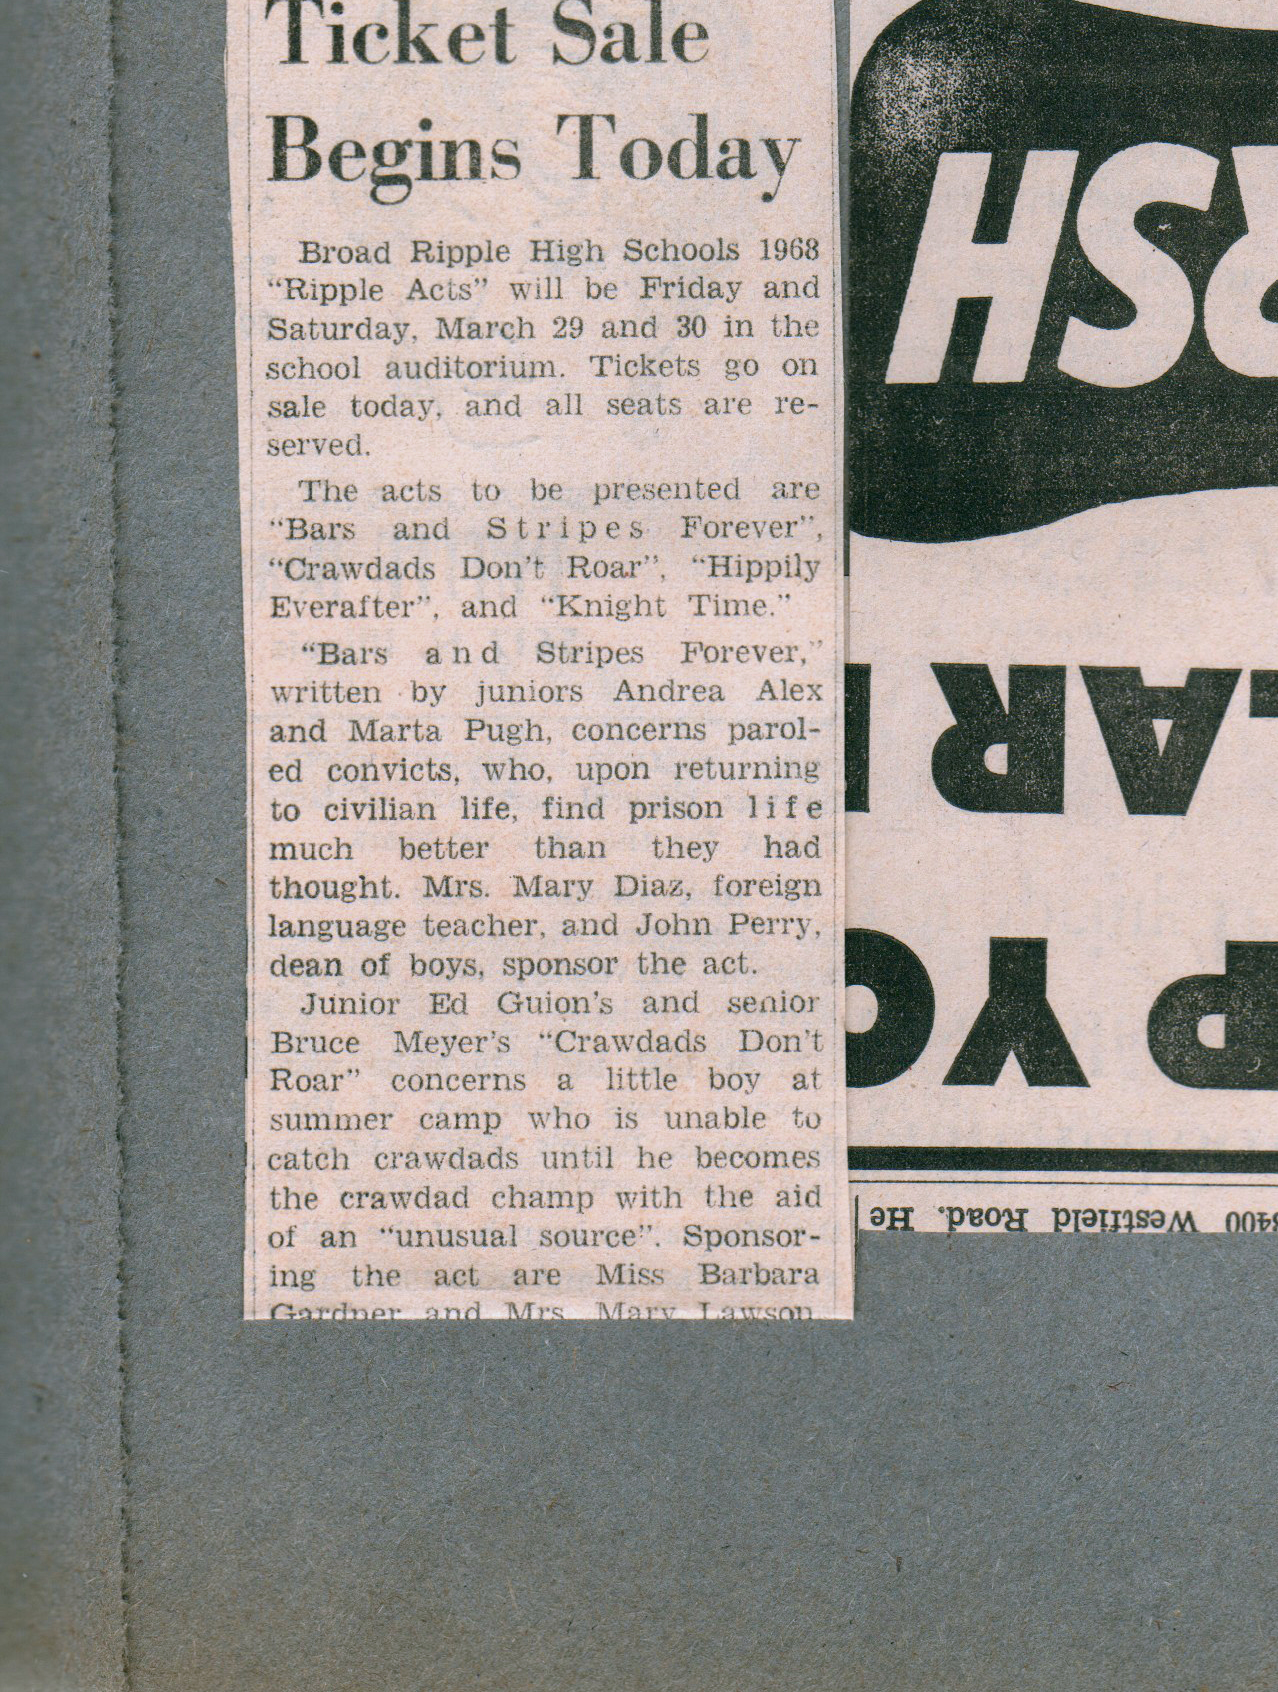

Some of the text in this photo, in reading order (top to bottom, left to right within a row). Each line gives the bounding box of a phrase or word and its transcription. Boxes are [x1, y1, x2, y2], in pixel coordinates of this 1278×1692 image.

[268, 114, 800, 203] Begins Today
[298, 237, 819, 268] Broad Ripple High Schools 1968
[268, 275, 819, 306] "Ripple Acts" will be Friday and
[268, 314, 819, 345] Saturday, March 29 and 30 in the
[265, 354, 817, 381] school auditorium. Tickets go on
[267, 393, 818, 421] sale today, and all seats are re-
[267, 433, 370, 457] served.
[298, 477, 820, 506] The acts to be presented are
[269, 553, 820, 583] "Crawdads Don't Roar", "Hippily
[270, 594, 790, 622] Everafter", and "Knight Time."
[271, 678, 822, 707] written by juniors Andrea Alex
[270, 717, 820, 746] and Marta Pugh, concerns parol-
[268, 756, 820, 785] ed convicts, who, upon returning
[271, 799, 301, 822] to
[324, 797, 436, 822] civilian
[461, 796, 517, 823] life,
[542, 796, 604, 820] find
[629, 796, 723, 824] prison
[269, 834, 820, 863] much better than they had
[269, 874, 822, 904] thought. Mrs. Mary Diaz, foreign
[268, 913, 820, 942] language teacher, and John Perry,
[270, 952, 757, 981] dean of boys, sponsor the act.
[300, 990, 820, 1015] Junior Ed Guion's and senior
[271, 1029, 822, 1057] Bruce Meyer's "Crawdads Don't
[270, 1067, 820, 1094] Roar" concerns a little boy at
[270, 1105, 821, 1135] summer camp who is unable to
[267, 1146, 820, 1171] catch crawdads until he becomes
[270, 1184, 821, 1214] the crawdad champ with the aid
[870, 1206, 915, 1231] He
[938, 1206, 1029, 1232] Road.
[1051, 1207, 1199, 1233] Westfield
[268, 1224, 821, 1252] of an "unusual source". Sponsor-
[270, 1262, 819, 1292] ing the act are Miss Barbara
